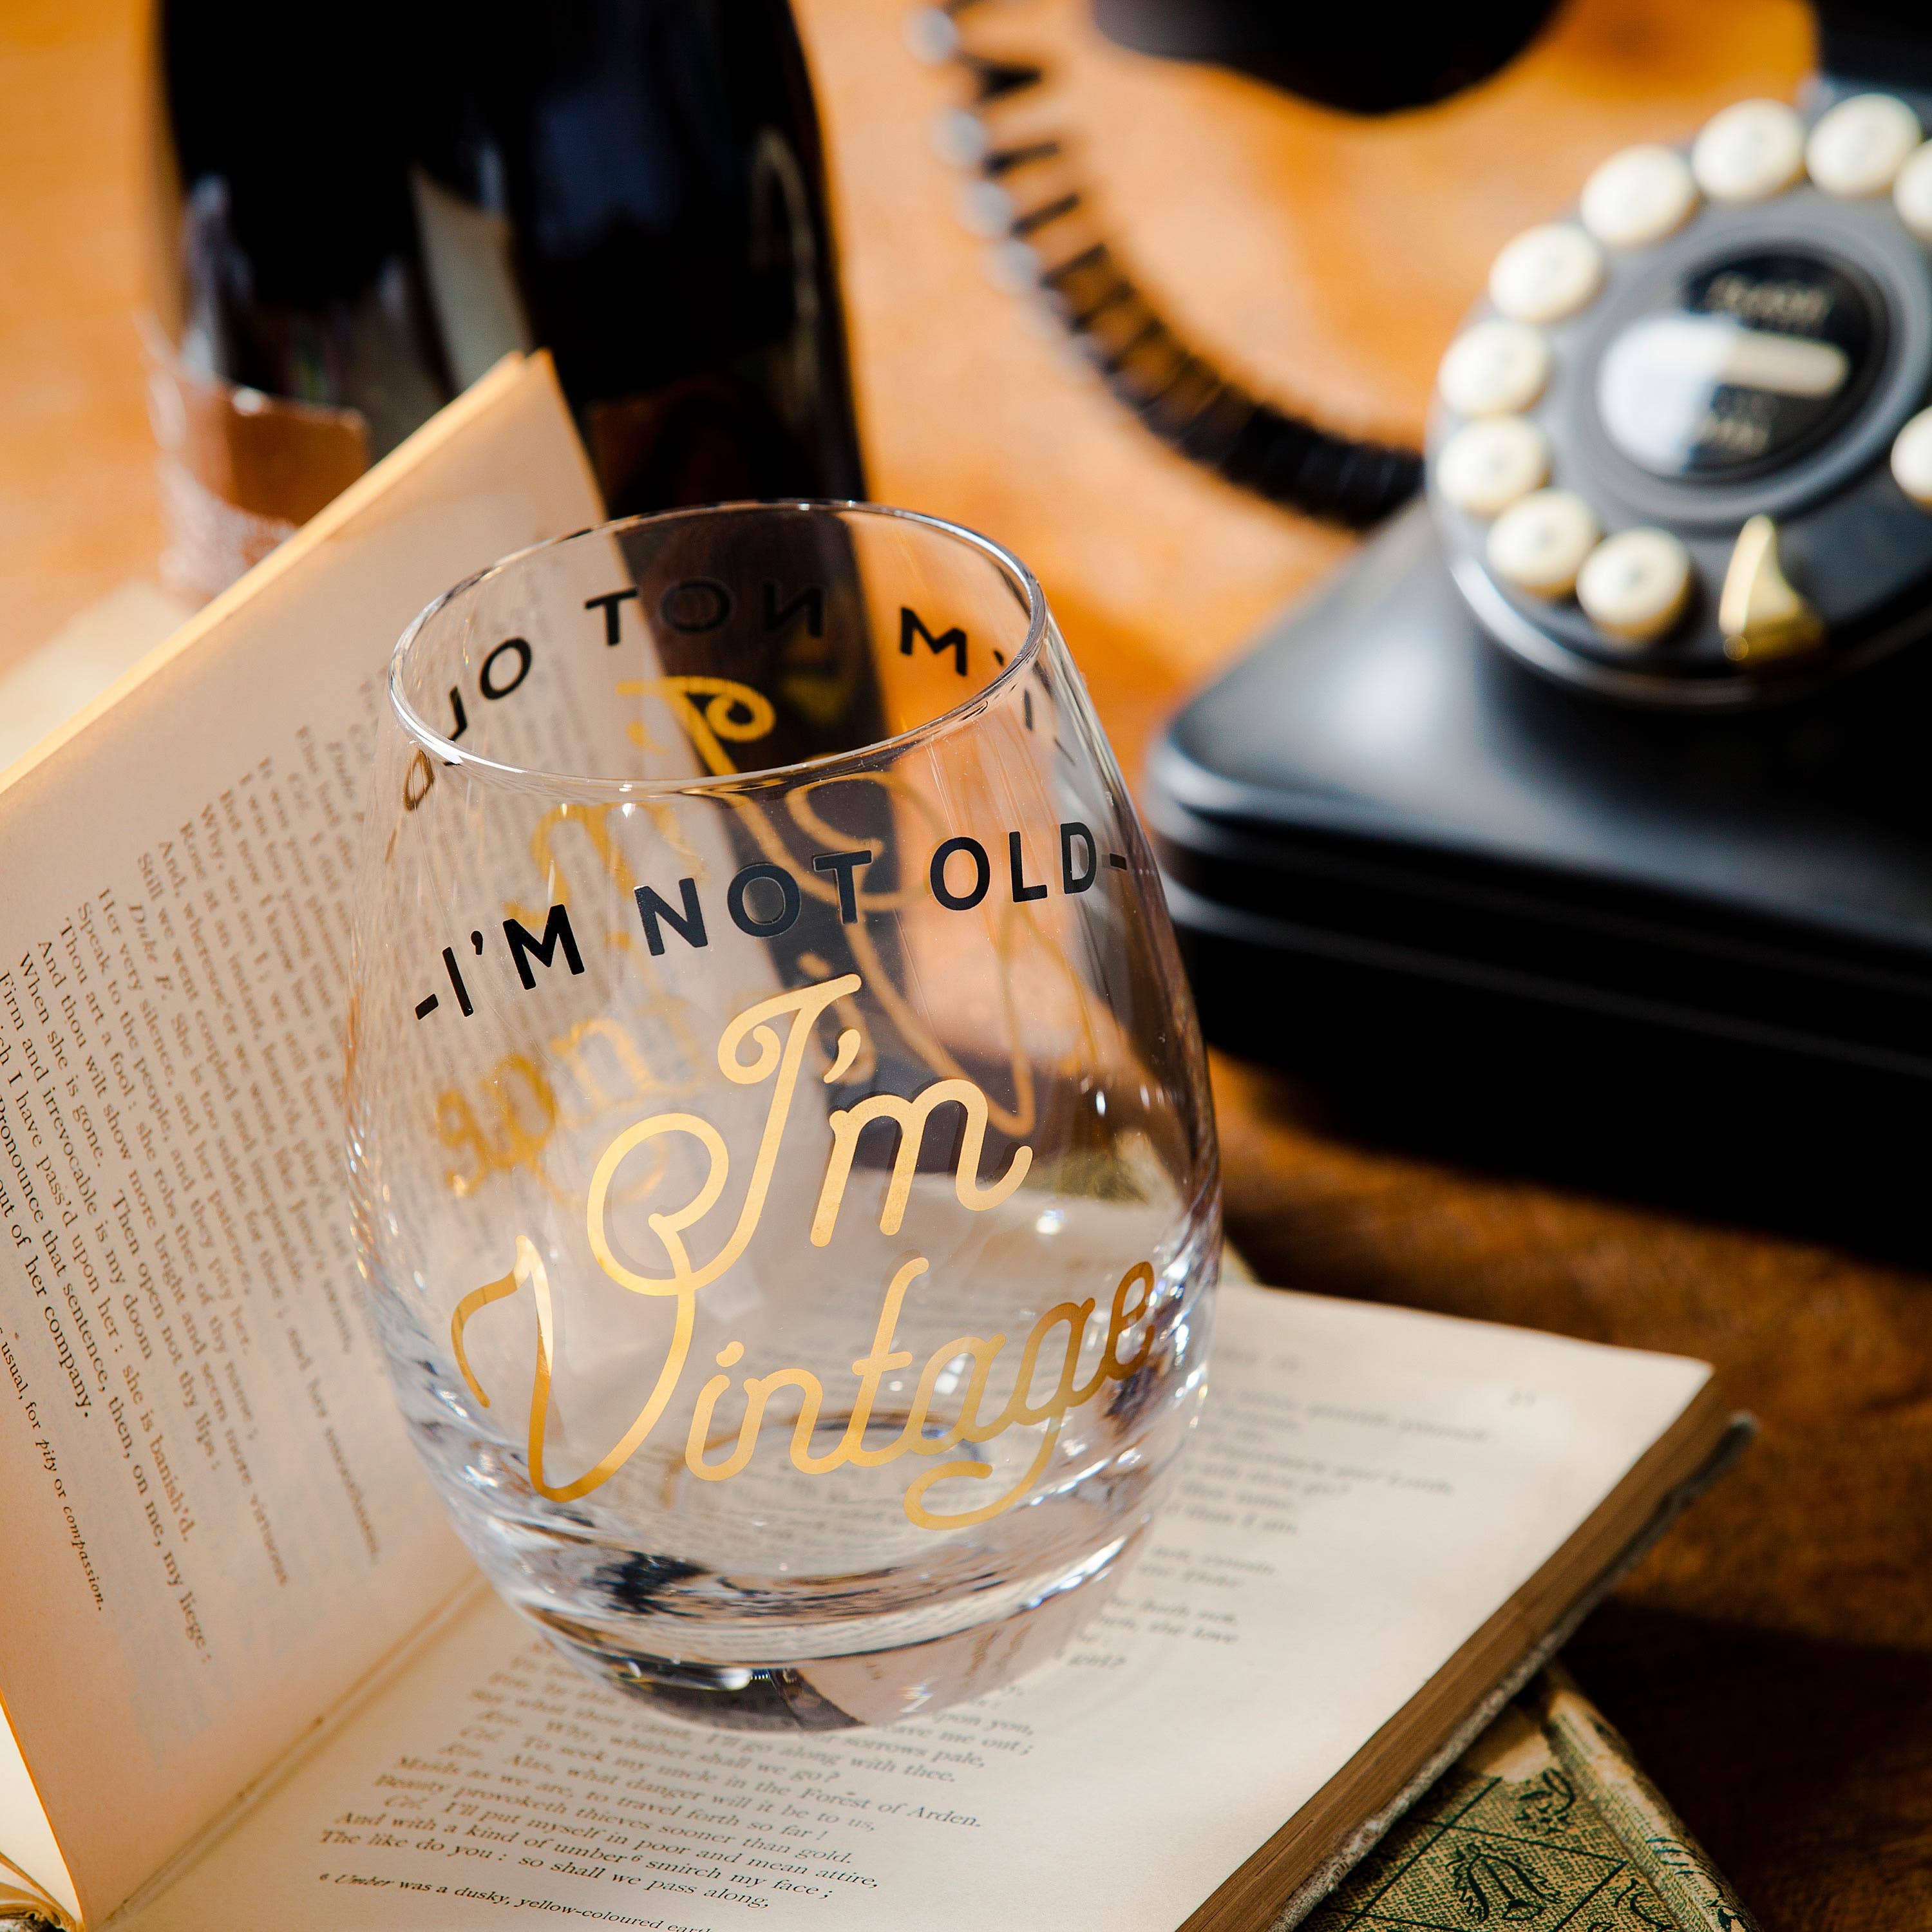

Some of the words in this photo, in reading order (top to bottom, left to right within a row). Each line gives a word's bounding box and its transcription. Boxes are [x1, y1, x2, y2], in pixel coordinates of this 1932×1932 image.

[634, 848, 872, 956] NOT
[19, 952, 50, 1025] When
[128, 904, 158, 963] Duke
[171, 1012, 193, 1059] She
[189, 1063, 203, 1086] is
[199, 1090, 220, 1131] too
[137, 852, 165, 902] Still
[158, 907, 175, 939] we
[172, 946, 200, 1002] went
[231, 1108, 258, 1154] and
[47, 1030, 68, 1067] she
[99, 887, 121, 934] Her
[119, 943, 144, 991] very
[139, 998, 175, 1088] silence,
[174, 1092, 201, 1137] and
[193, 1139, 215, 1181] her
[8, 1071, 23, 1085] I
[66, 1074, 79, 1097] is
[77, 902, 111, 975] Speak
[107, 980, 121, 1006] to
[119, 1010, 139, 1050] the
[133, 1056, 171, 1142] people,
[170, 1149, 196, 1193] and
[189, 1198, 215, 1249] they
[207, 1256, 234, 1300] pity
[15, 1090, 42, 1148] have
[60, 917, 88, 985] Thou
[85, 991, 105, 1025] art
[101, 1031, 112, 1047] a
[136, 1121, 156, 1162] she
[153, 1168, 177, 1219] robs
[175, 1222, 199, 1274] thee
[196, 1282, 216, 1307] of
[209, 1315, 228, 1354] thy
[72, 1104, 103, 1168] gone.
[585, 973, 1033, 1297] I'm
[0, 971, 24, 1031] Firm
[22, 1038, 50, 1083] and
[43, 1086, 97, 1215] irrevocable
[95, 1220, 109, 1243] is
[105, 1249, 126, 1284] my
[123, 1293, 153, 1360] doom
[35, 1155, 79, 1228] pass'd
[37, 942, 67, 989] And
[61, 994, 87, 1049] thou
[85, 1055, 107, 1098] wilt
[103, 1104, 132, 1160] show
[128, 1169, 157, 1229] more
[154, 1233, 186, 1305] bright
[182, 1312, 208, 1357] and
[201, 1361, 228, 1423] seem
[224, 1428, 253, 1487] more
[113, 1189, 140, 1256] Then
[71, 1234, 100, 1294] upon
[138, 1262, 164, 1320] open
[11, 1224, 32, 1248] of
[24, 1255, 47, 1297] her
[44, 1306, 92, 1418] company.
[161, 1325, 183, 1367] not
[42, 1229, 67, 1278] that
[62, 1283, 108, 1392] sentence,
[108, 1396, 133, 1459] then,
[133, 1464, 148, 1495] on
[144, 1501, 164, 1547] me,
[162, 1551, 184, 1586] my
[122, 1364, 144, 1405] she
[179, 1370, 198, 1408] thy
[450, 1235, 1157, 1531] Vintage
[140, 1409, 154, 1432] is
[1, 1341, 29, 1400] usual,
[25, 1401, 41, 1429] for
[35, 1439, 57, 1472] pity
[54, 1478, 67, 1498] or
[62, 1506, 104, 1611] compassion.
[149, 1434, 195, 1542] banish'd.
[567, 1767, 620, 1785] what
[625, 1777, 705, 1801] danger
[712, 1795, 753, 1809] will
[755, 1801, 774, 1813] it
[781, 1804, 810, 1819] be
[817, 1812, 840, 1823] to
[850, 1757, 897, 1773] with
[903, 1764, 955, 1783] thee.
[930, 1750, 985, 1768] pale,
[452, 1786, 567, 1815] provoketh
[575, 1808, 653, 1830] thieves
[658, 1826, 736, 1844] sooner
[742, 1837, 791, 1853] than
[794, 1849, 852, 1864] gold.
[466, 1768, 491, 1780] as
[500, 1774, 529, 1786] we
[535, 1782, 574, 1799] are,
[585, 1790, 610, 1802] to
[617, 1797, 683, 1816] travel
[686, 1809, 740, 1826] forth
[746, 1822, 773, 1832] so
[724, 1776, 747, 1789] in
[754, 1781, 791, 1796] the
[799, 1787, 871, 1810] Forest
[877, 1803, 908, 1814] of
[907, 1806, 981, 1828] Arden.
[320, 1829, 361, 1844] The
[368, 1833, 408, 1848] like
[415, 1839, 445, 1851] do
[518, 1857, 544, 1867] so
[550, 1861, 606, 1879] shall
[612, 1873, 641, 1885] we
[644, 1880, 697, 1893] pass
[703, 1888, 768, 1908] along,
[336, 1812, 387, 1826] And
[392, 1818, 437, 1831] with
[443, 1824, 458, 1833] a
[465, 1824, 520, 1843] kind
[524, 1838, 554, 1849] of
[645, 1861, 721, 1879] smirch
[730, 1874, 766, 1888] my
[442, 1801, 480, 1817] I'll
[478, 1810, 521, 1824] put
[527, 1819, 607, 1839] myself
[606, 1832, 629, 1845] in
[632, 1840, 691, 1855] poor
[696, 1851, 743, 1863] and
[747, 1859, 808, 1875] mean
[815, 1871, 878, 1889] attire,
[334, 1874, 395, 1887] Umber
[399, 1881, 432, 1891] was
[454, 1887, 510, 1905] dusky,
[513, 1899, 665, 1929] yellow-coloured
[667, 1920, 712, 1932] eart
